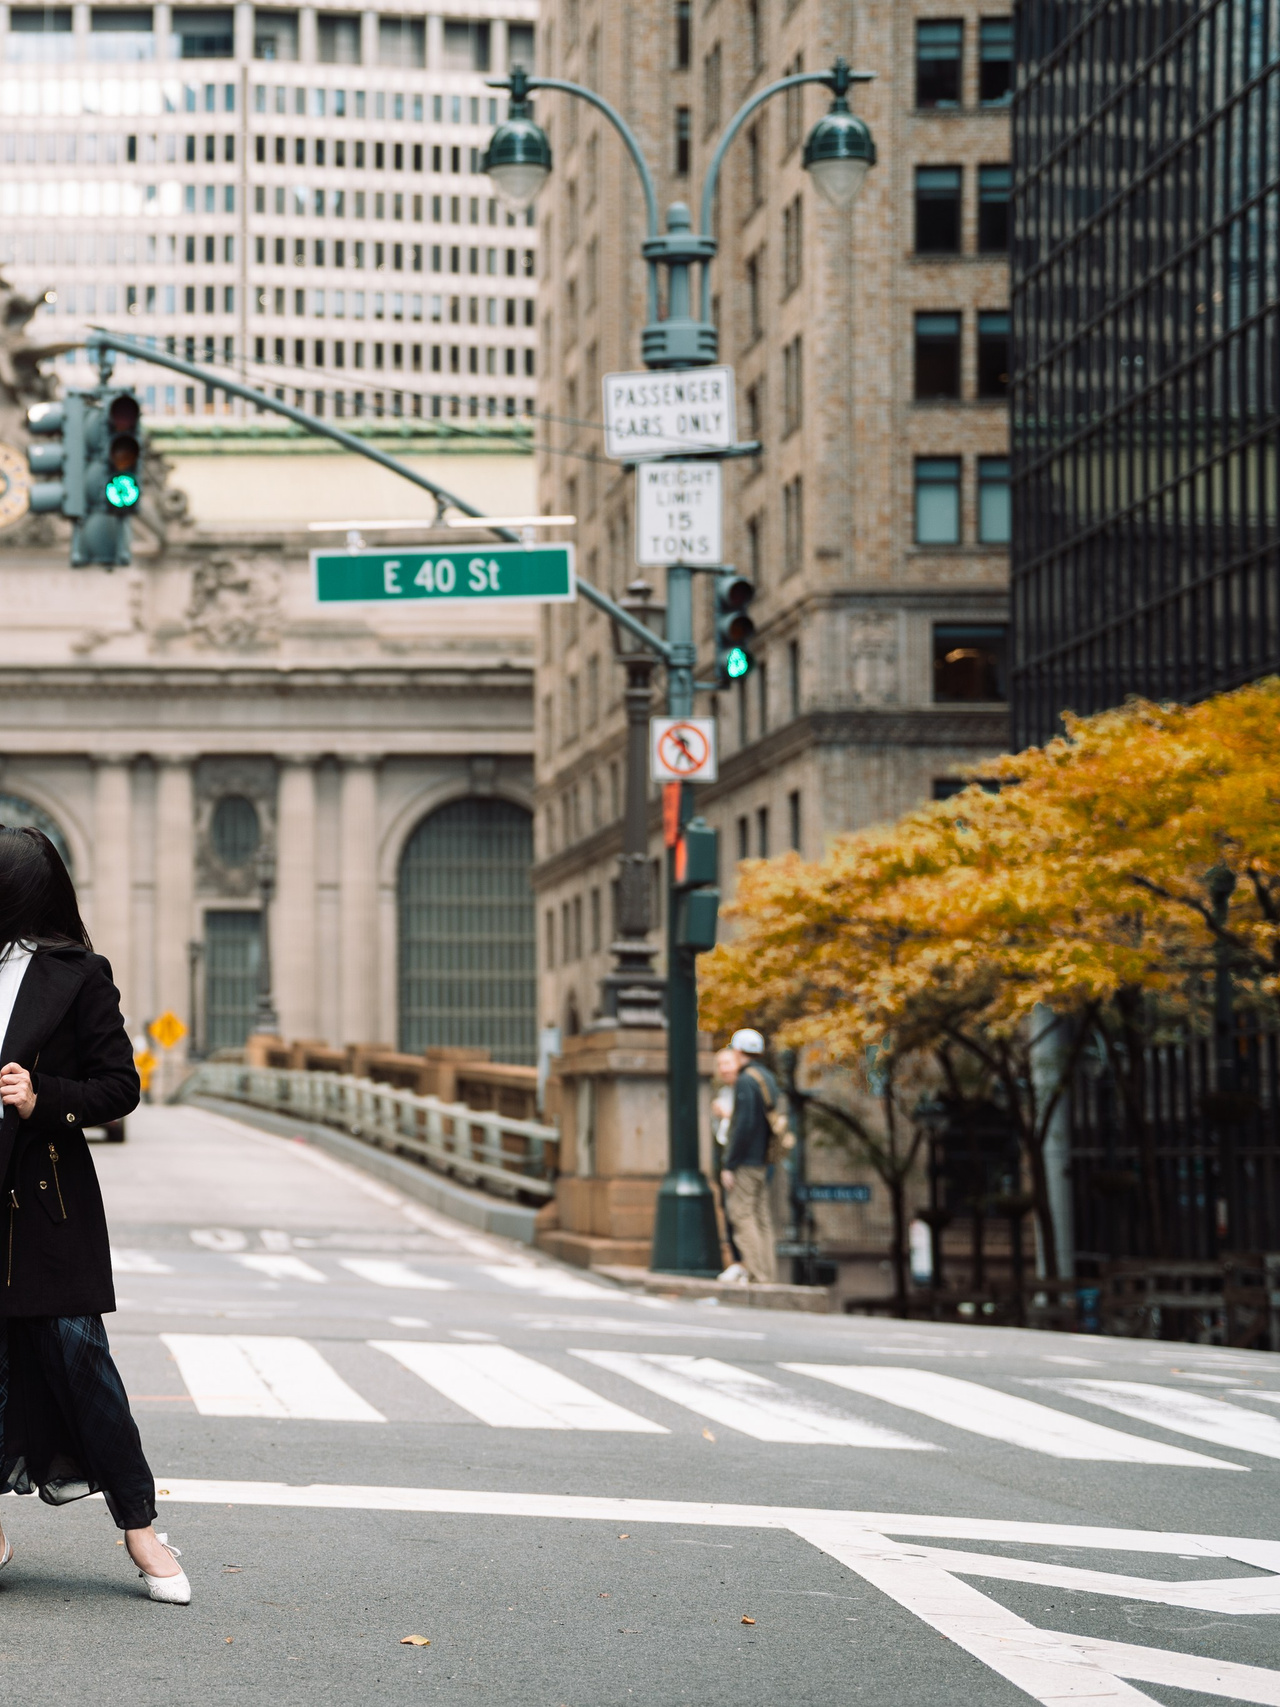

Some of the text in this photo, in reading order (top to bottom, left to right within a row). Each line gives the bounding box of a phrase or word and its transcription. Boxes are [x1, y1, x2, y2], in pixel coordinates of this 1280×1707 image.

[614, 381, 722, 408] PASSENGER
[615, 411, 723, 438] CARS ONLY
[647, 469, 713, 485] WEIGHT
[657, 490, 702, 506] LIMIT
[667, 511, 693, 531] 15
[651, 536, 710, 555] TONS
[383, 557, 501, 594] E 40 St
